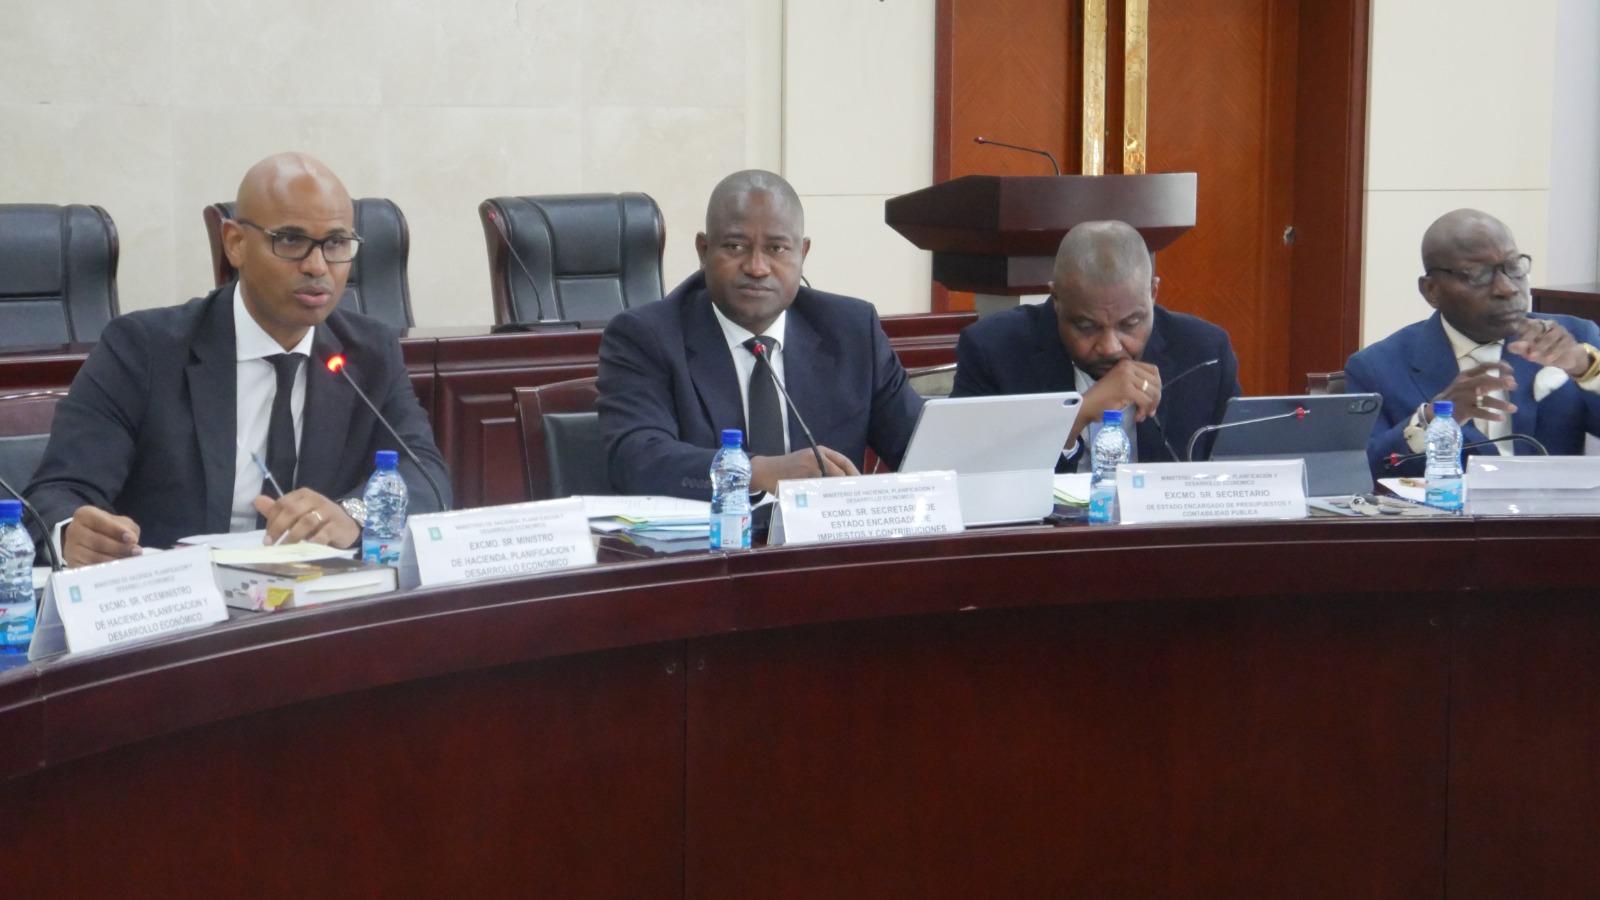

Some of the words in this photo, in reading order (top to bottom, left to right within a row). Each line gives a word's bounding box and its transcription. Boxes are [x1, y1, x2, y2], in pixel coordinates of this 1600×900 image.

[822, 490, 853, 498] MINISTERIO
[1216, 490, 1270, 498] SECRETARIO
[870, 503, 921, 515] SECRETARI
[830, 520, 864, 529] ESTADO
[516, 533, 554, 545] MINISTRO
[818, 530, 866, 542] IMPUESTOS
[867, 529, 873, 537] Y
[876, 524, 947, 537] CONTRIBUCIONES
[451, 558, 462, 568] DE
[464, 564, 520, 578] DESARROLLO
[142, 585, 192, 604] VICEMINISTRO
[94, 621, 107, 631] DE
[107, 622, 159, 642] DESARROLLO
